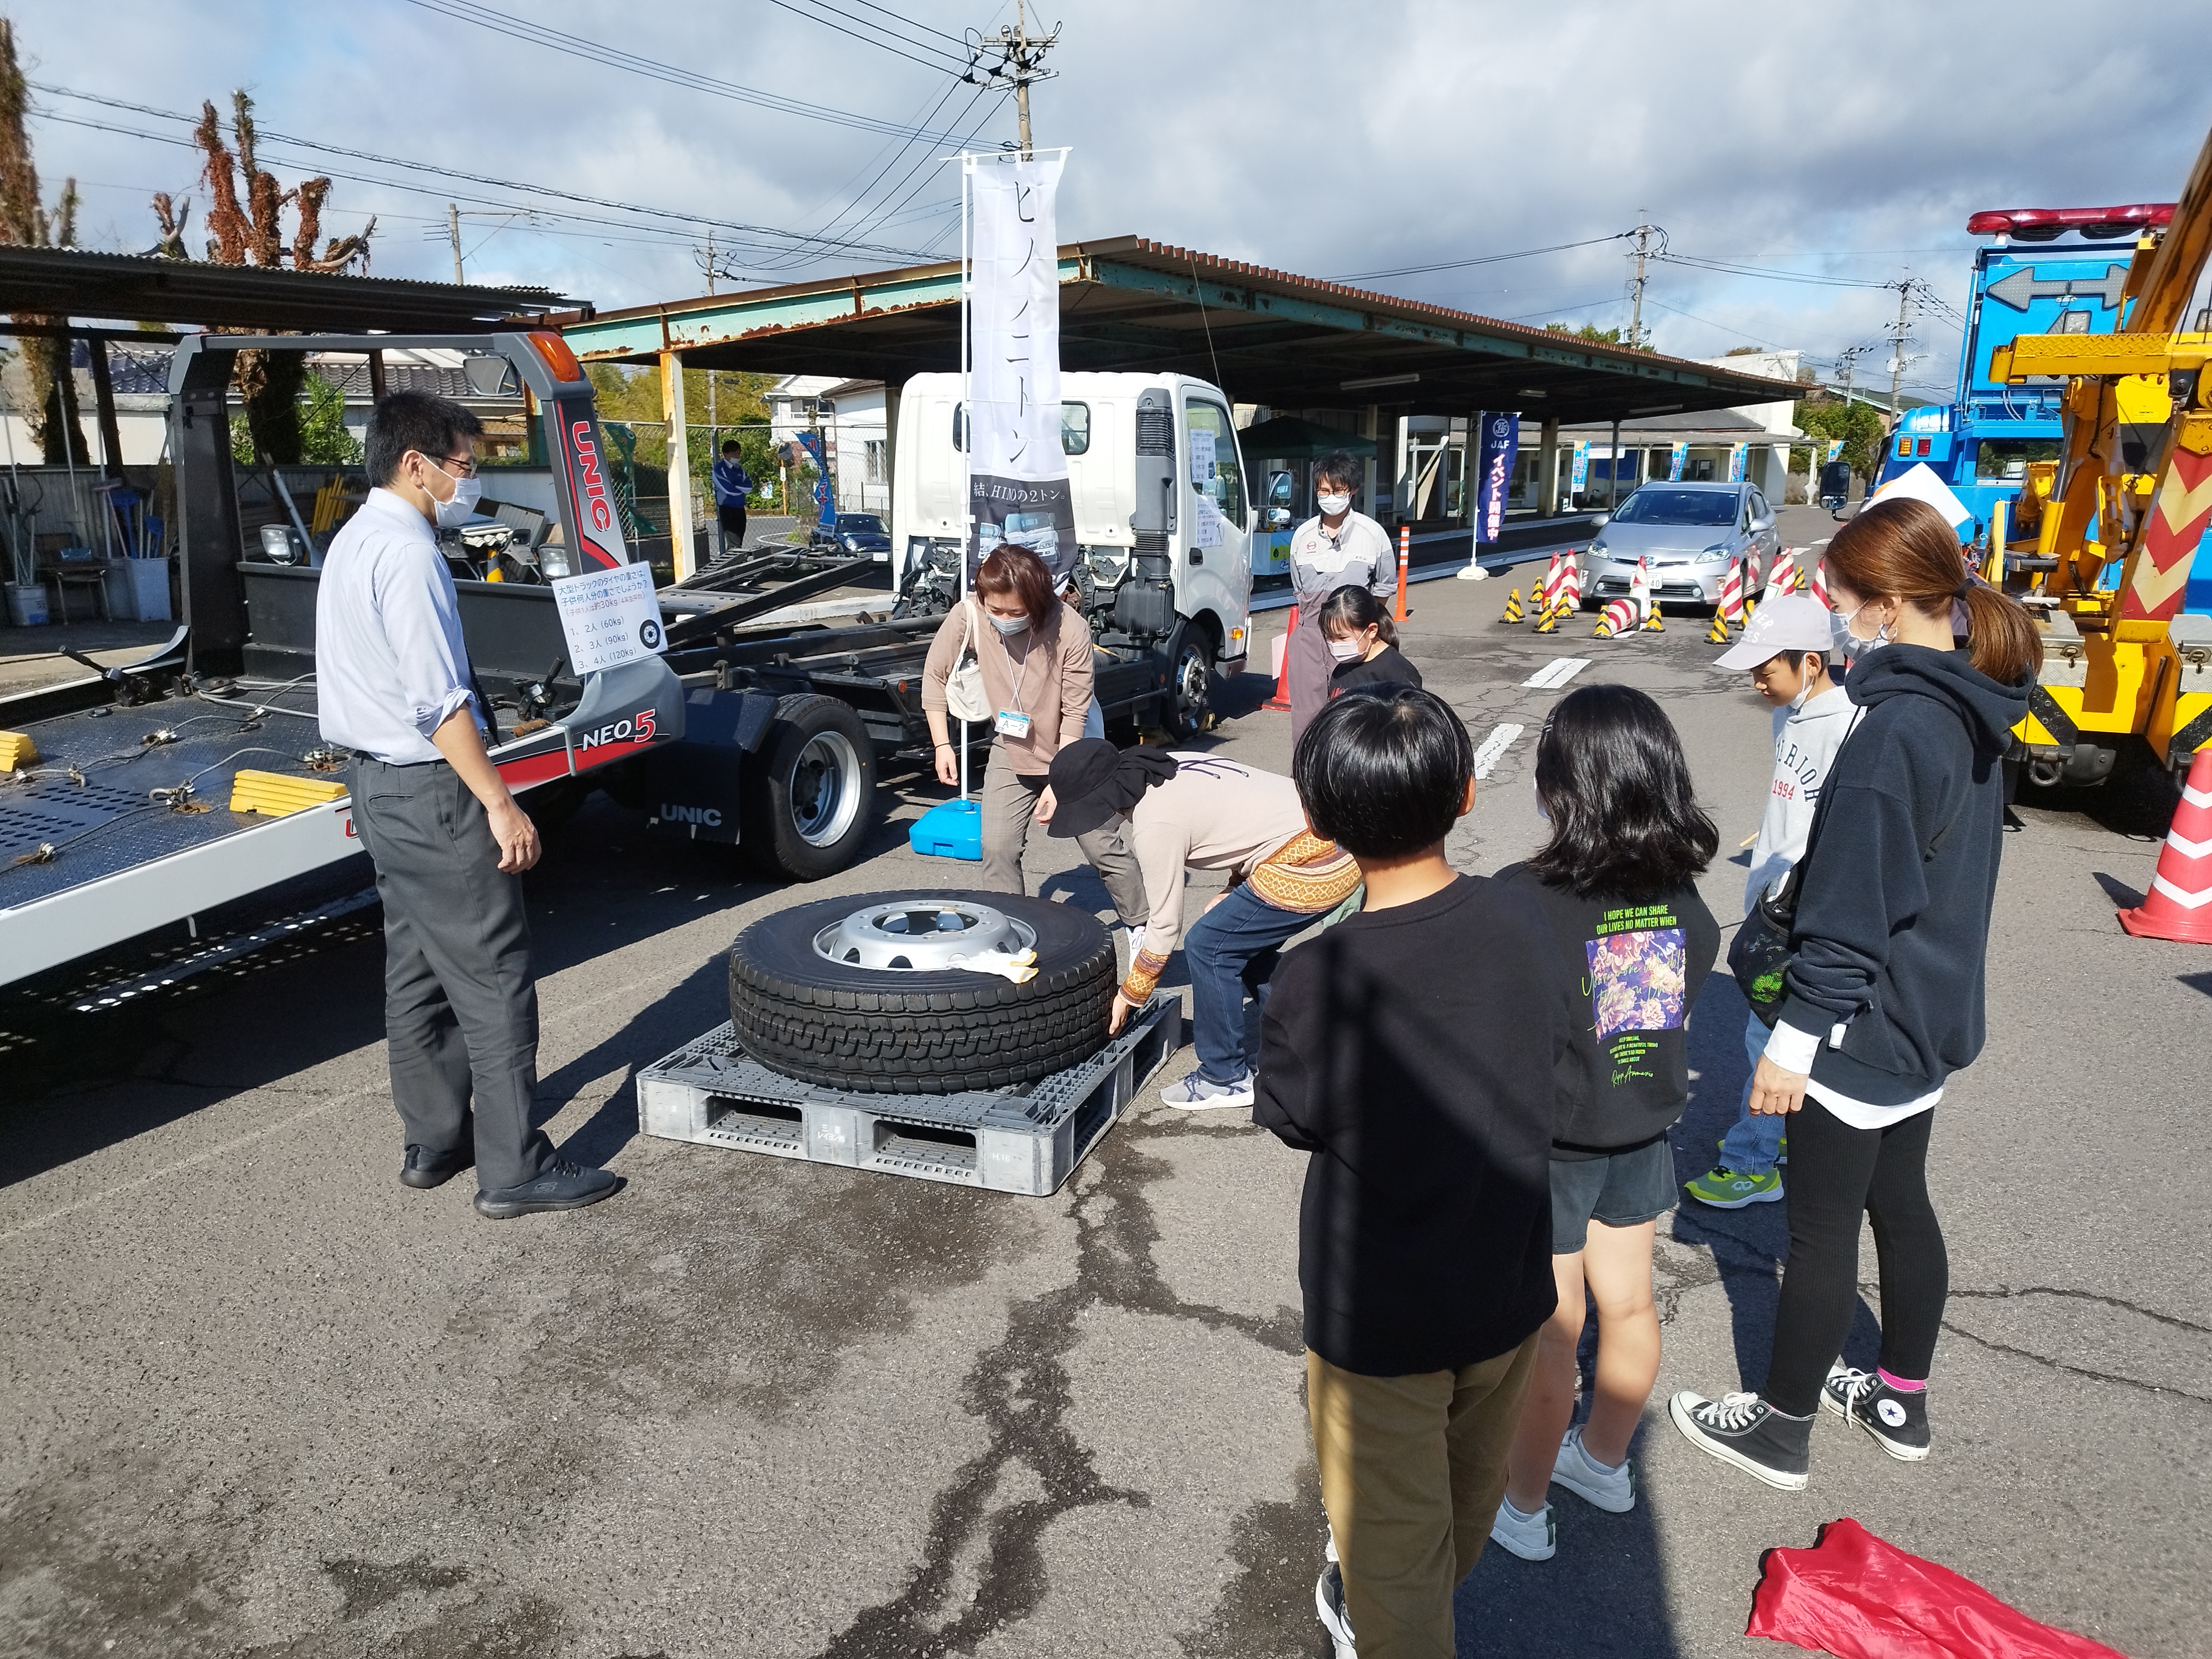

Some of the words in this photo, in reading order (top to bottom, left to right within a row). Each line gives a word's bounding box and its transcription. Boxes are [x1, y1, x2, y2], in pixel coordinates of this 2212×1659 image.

[1005, 181, 1036, 464] ヒノノニトン
[1491, 440, 1510, 449] JAF
[572, 420, 612, 533] UNIC
[1486, 453, 1506, 541] イベント開催中
[1771, 779, 1795, 801] 1994
[661, 803, 722, 826] UNIC
[1603, 911, 1606, 921] I
[1608, 909, 1624, 921] HOPE
[1625, 907, 1634, 918] WE
[1635, 906, 1648, 916] CAN
[1648, 904, 1669, 916] SHARE
[1596, 924, 1608, 935] OUR
[1608, 920, 1625, 932] LIVES
[1625, 920, 1634, 930] NO
[1635, 917, 1658, 929] MATTER
[1660, 915, 1677, 926] WHEN
